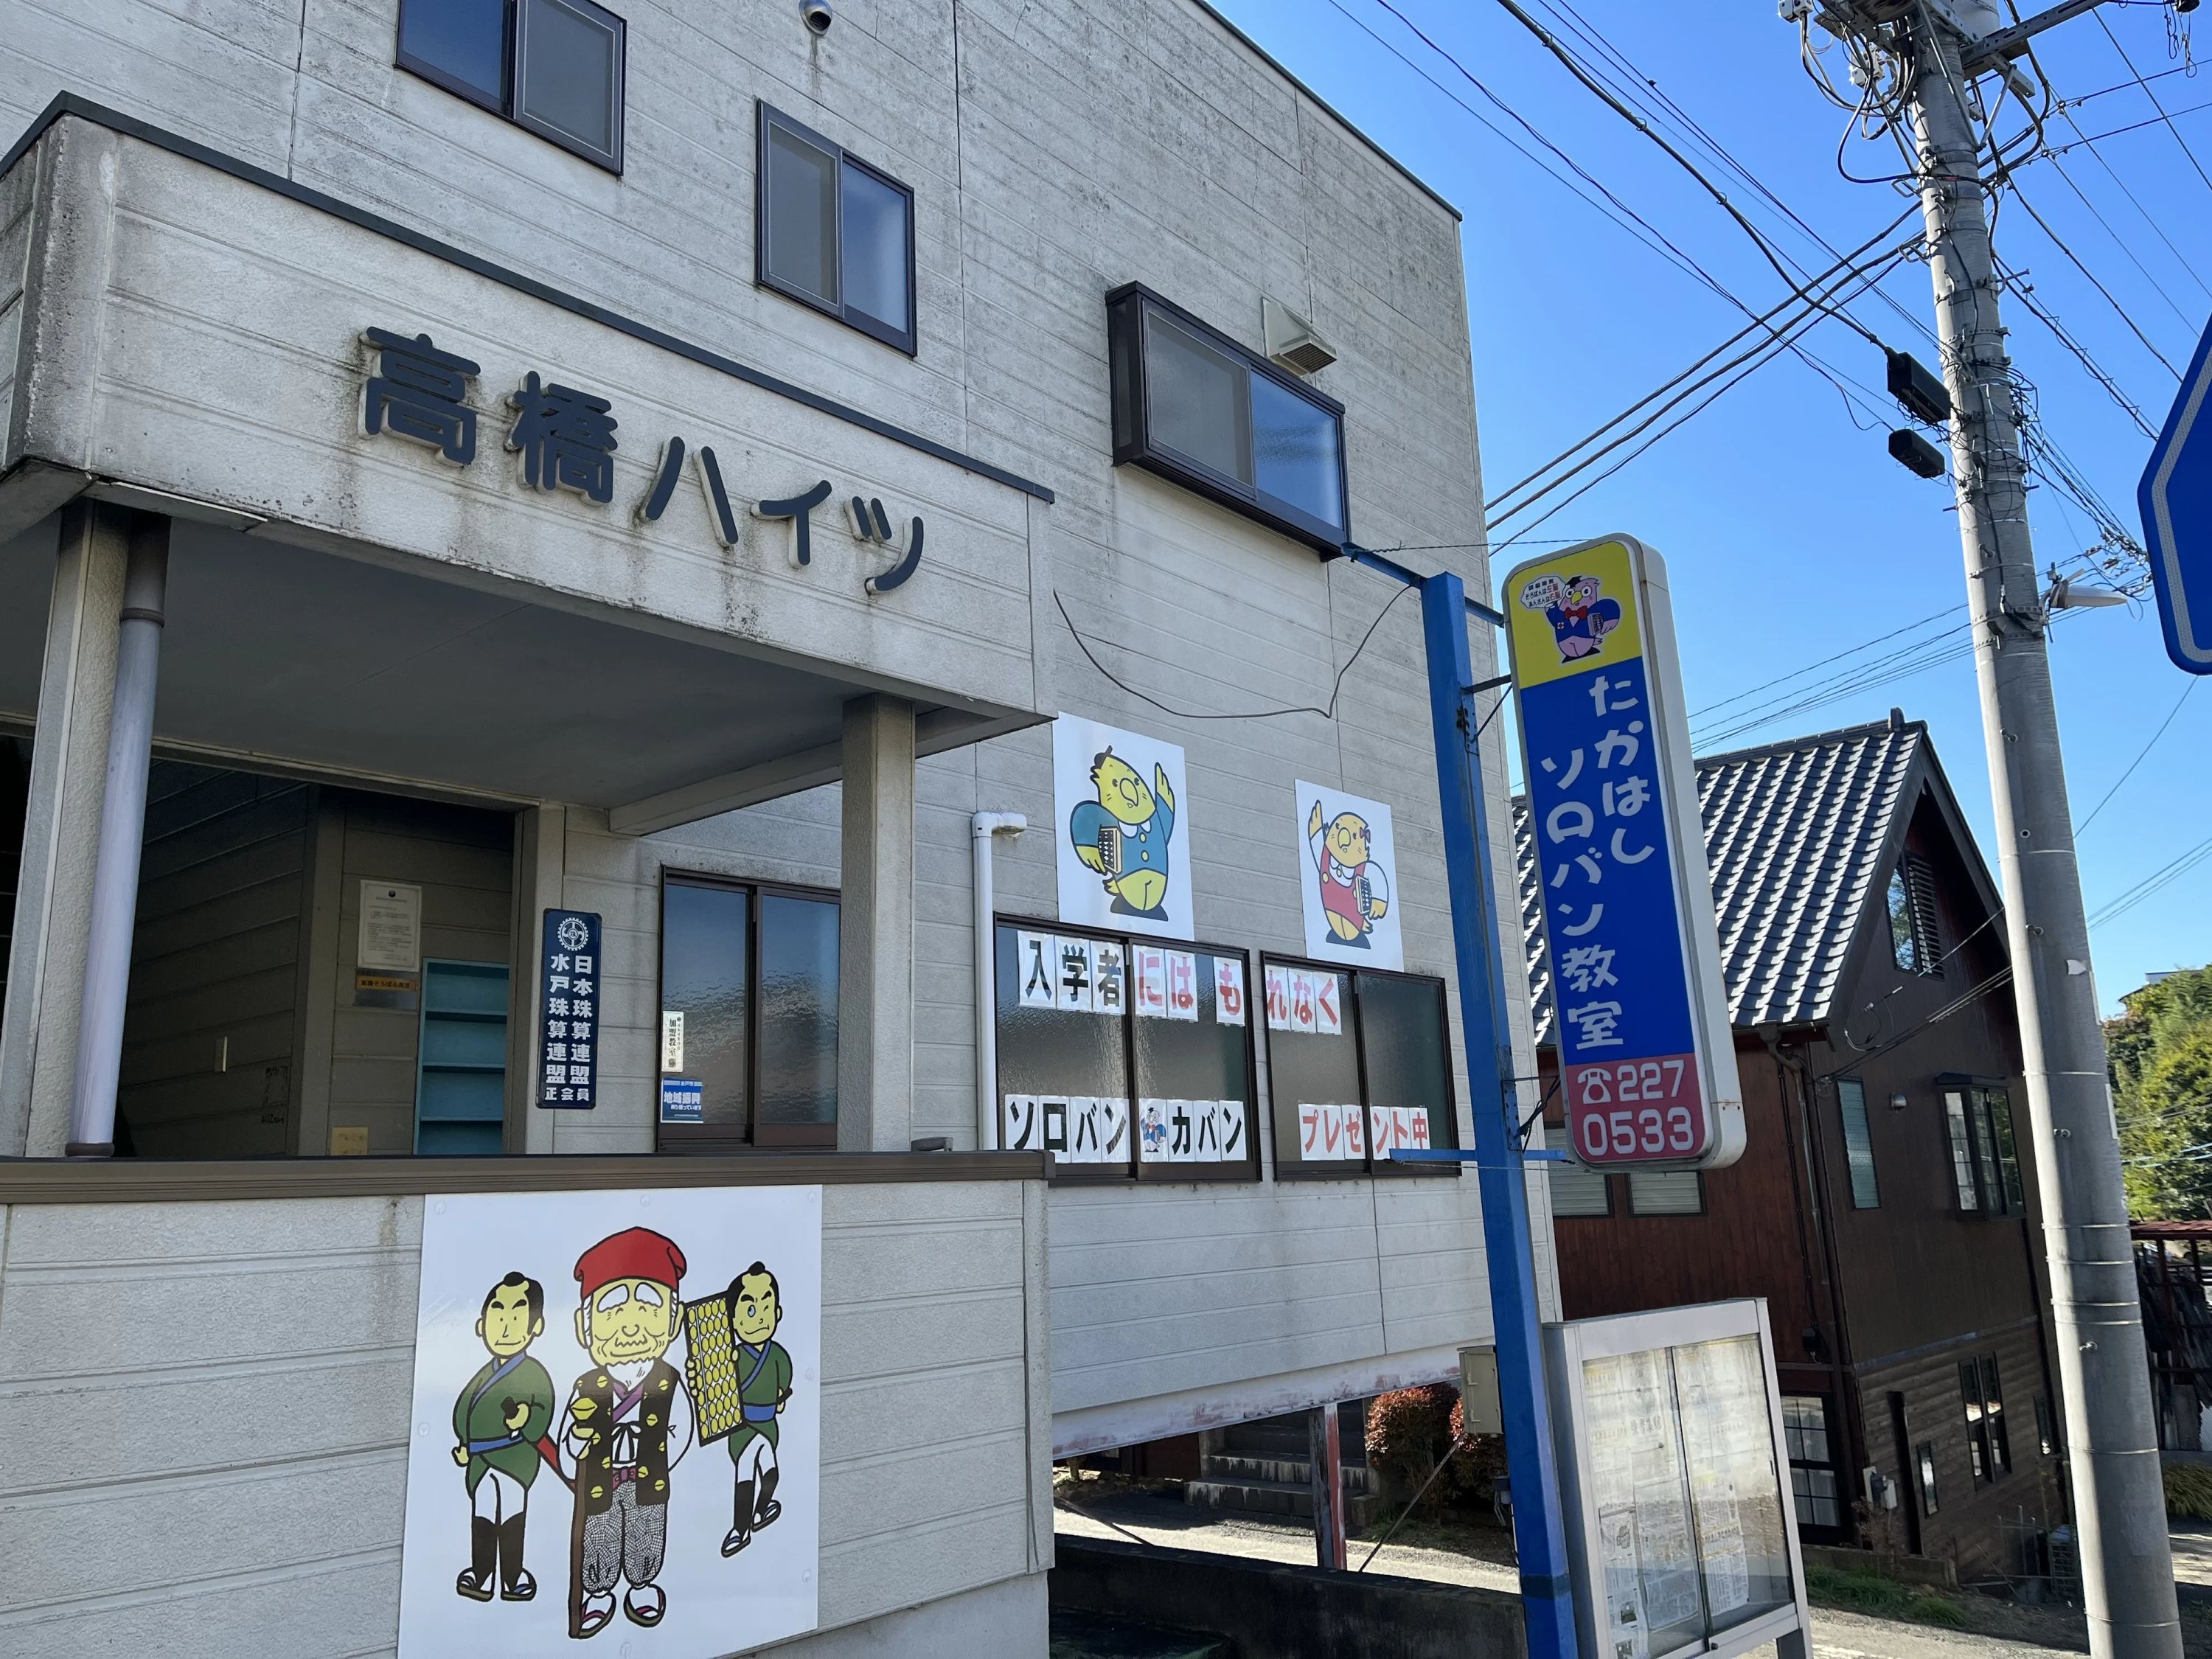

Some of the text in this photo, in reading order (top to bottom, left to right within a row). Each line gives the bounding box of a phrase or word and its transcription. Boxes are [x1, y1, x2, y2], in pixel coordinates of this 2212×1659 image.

[361, 326, 925, 593] 高橋ハイツ
[1588, 675, 1655, 864] たかはし
[1540, 748, 1623, 1050] ソロバン教室
[546, 953, 570, 1085] 水戸珠算連盟
[570, 955, 593, 1085] 日本珠算連盟
[1616, 1060, 1684, 1102] 227
[544, 1087, 590, 1102] 正会員
[1582, 1106, 1694, 1157] 0533
